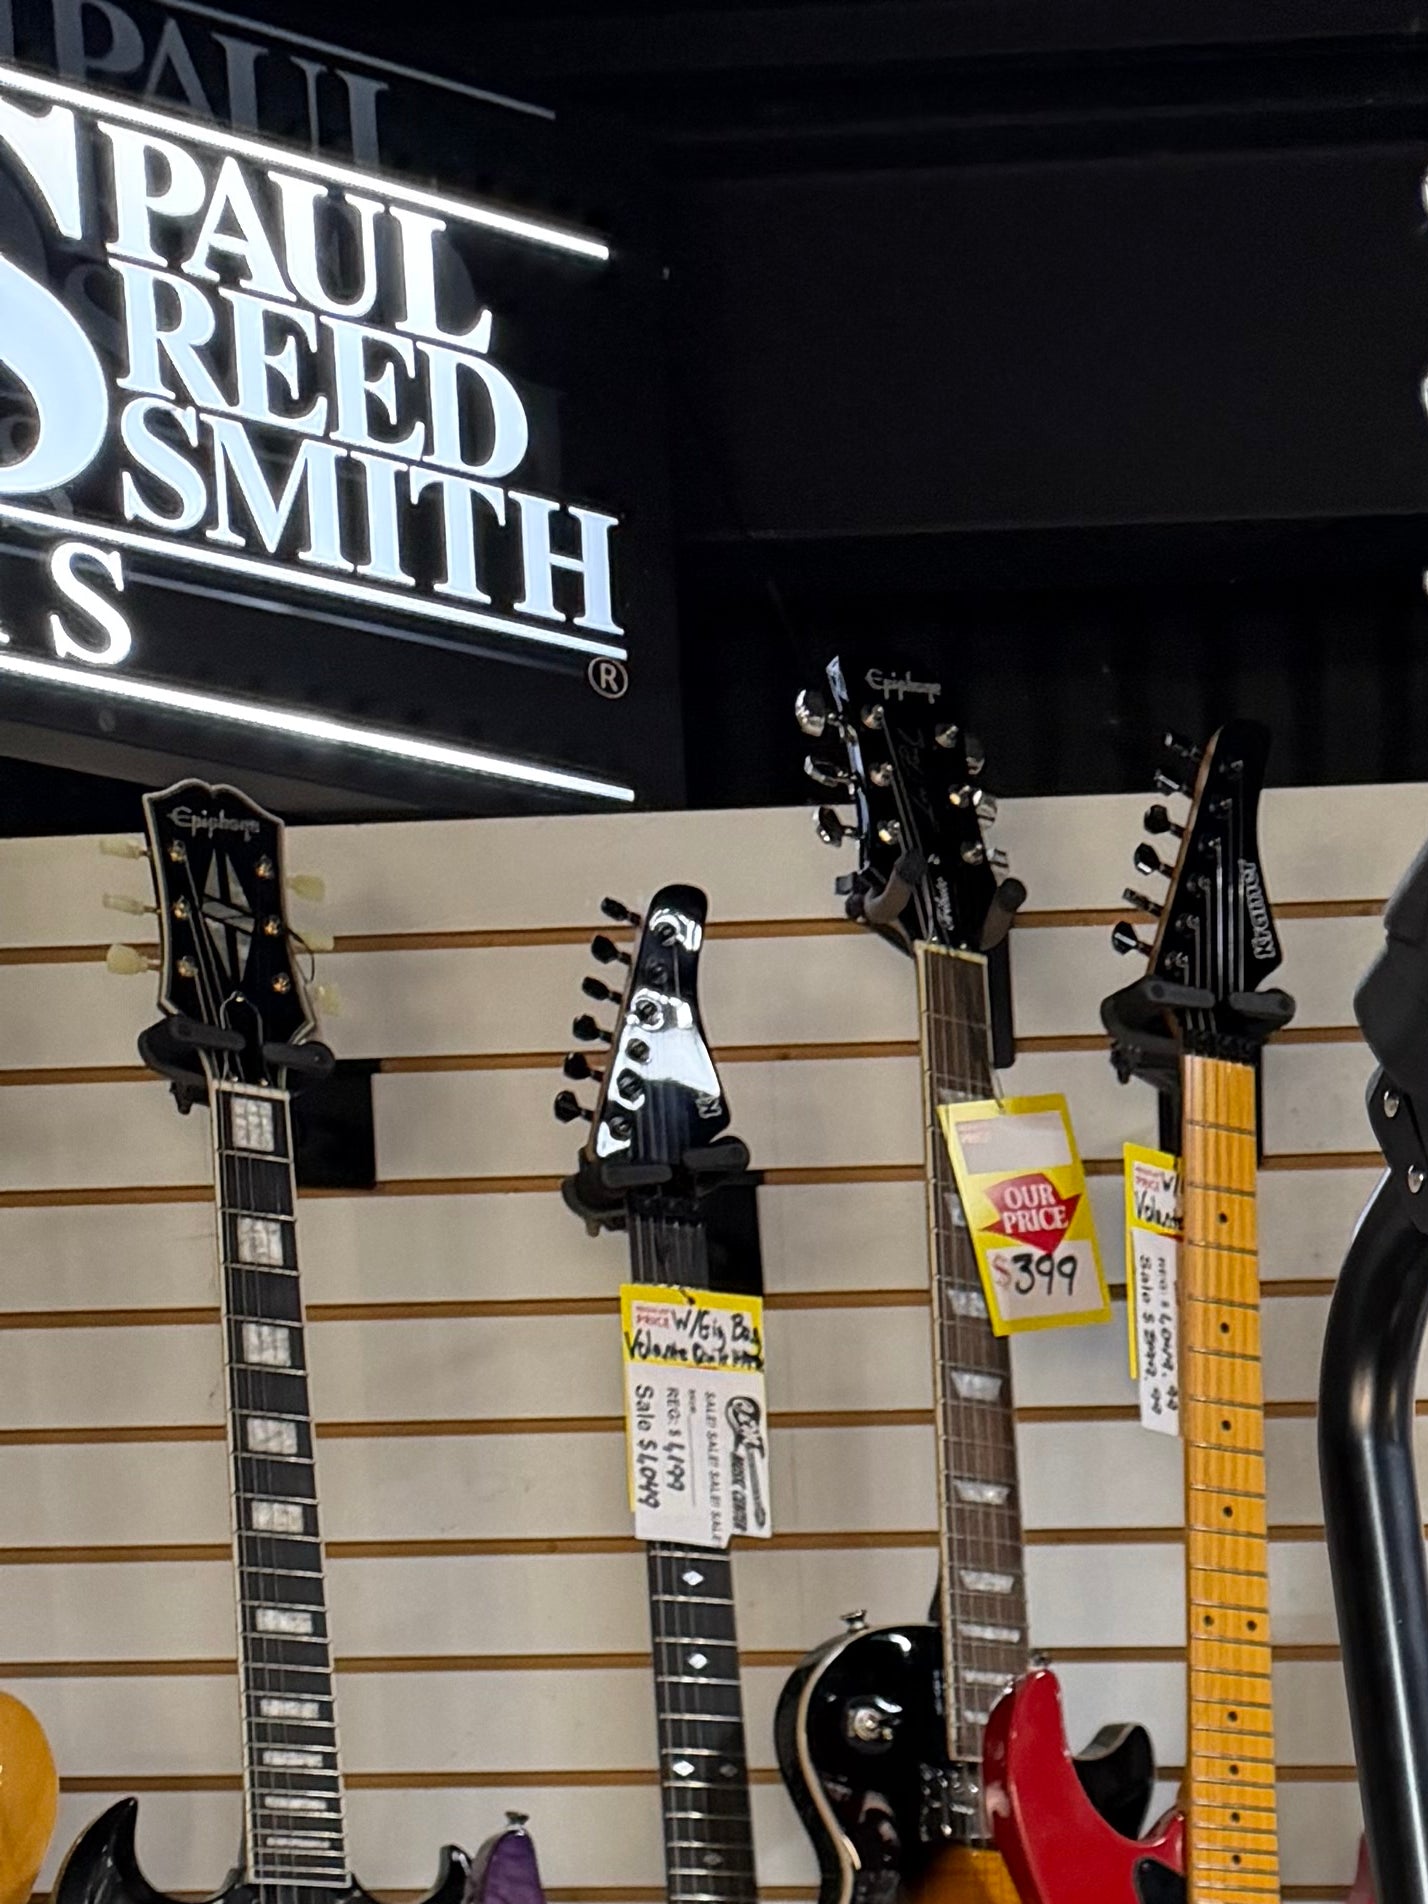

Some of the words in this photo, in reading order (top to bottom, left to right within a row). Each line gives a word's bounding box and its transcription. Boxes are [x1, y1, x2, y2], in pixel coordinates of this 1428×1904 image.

[98, 119, 493, 354] PAUL
[108, 257, 530, 480] REED
[120, 397, 625, 637] SMITH
[1002, 1206, 1069, 1234] PRICE
[1004, 1183, 1056, 1210] OUR
[992, 1253, 1077, 1296] $399
